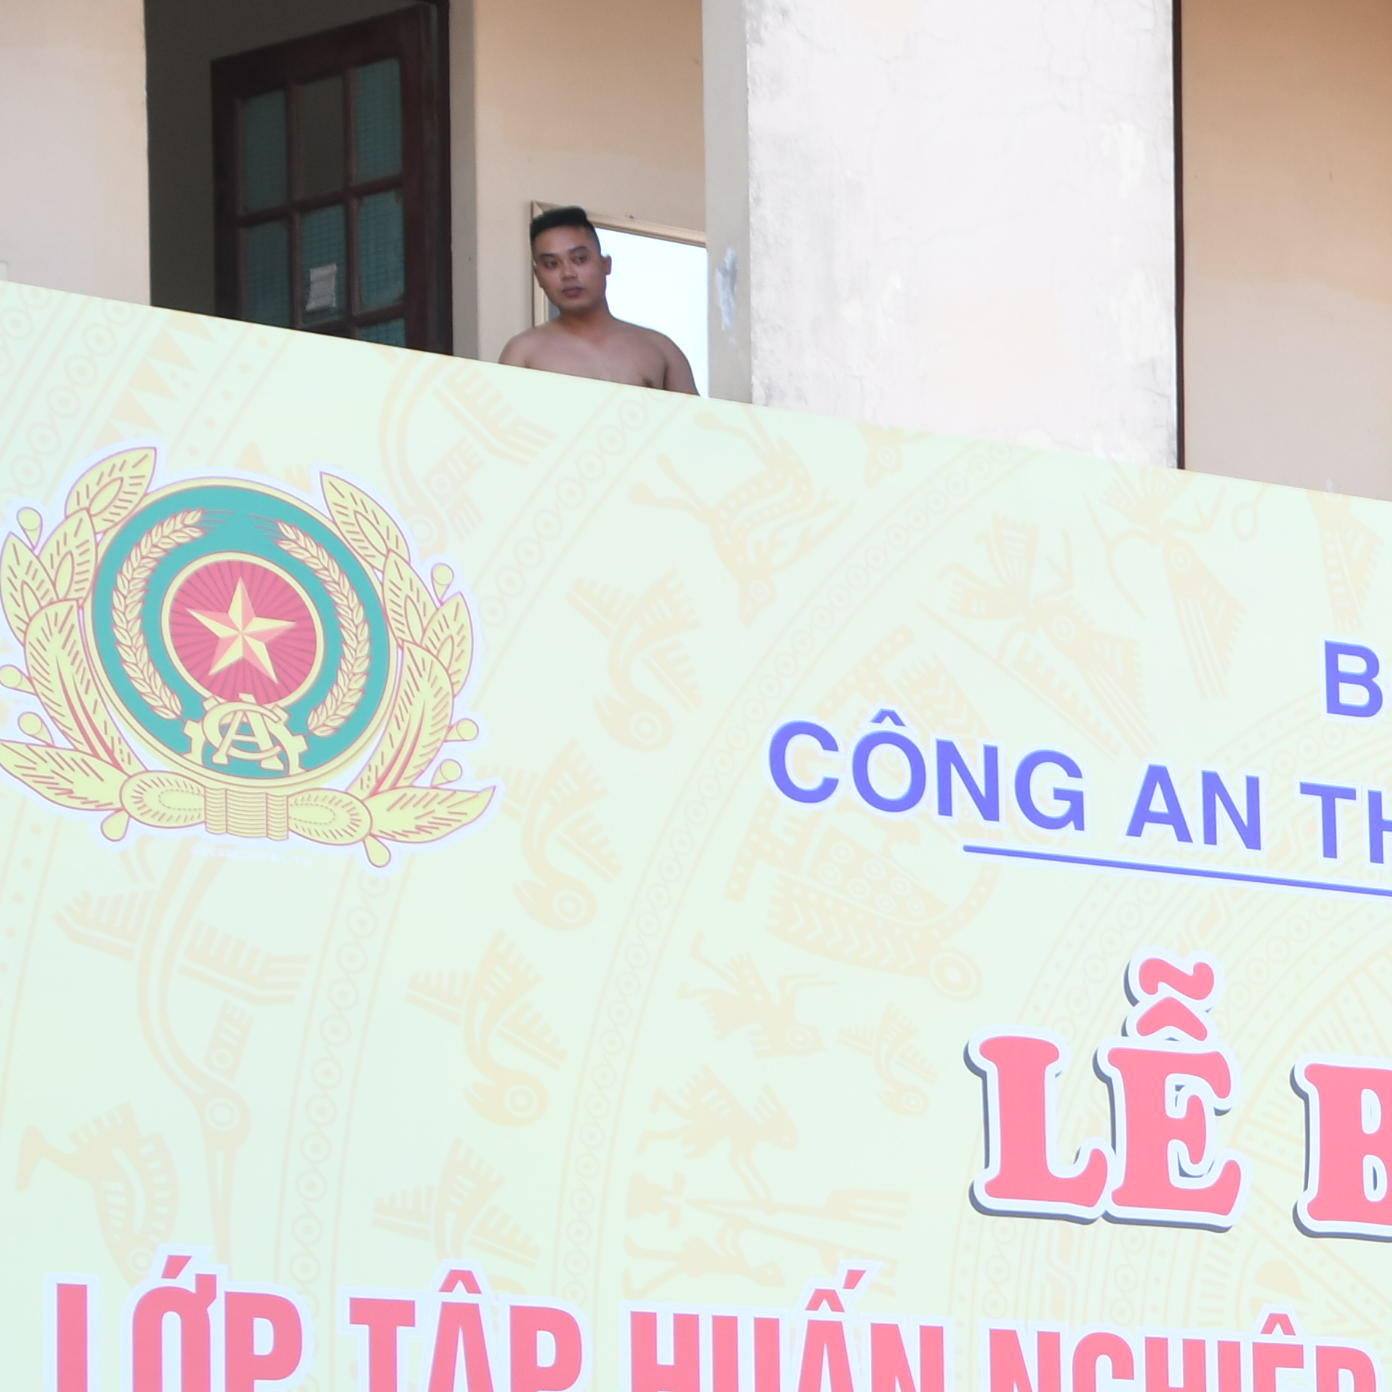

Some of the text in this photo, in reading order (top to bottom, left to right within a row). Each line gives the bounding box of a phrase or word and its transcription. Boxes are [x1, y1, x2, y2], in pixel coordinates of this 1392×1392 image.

[768, 708, 1086, 832] CÔNG
[1125, 763, 1262, 852] AN
[979, 958, 1242, 1216] LỄ
